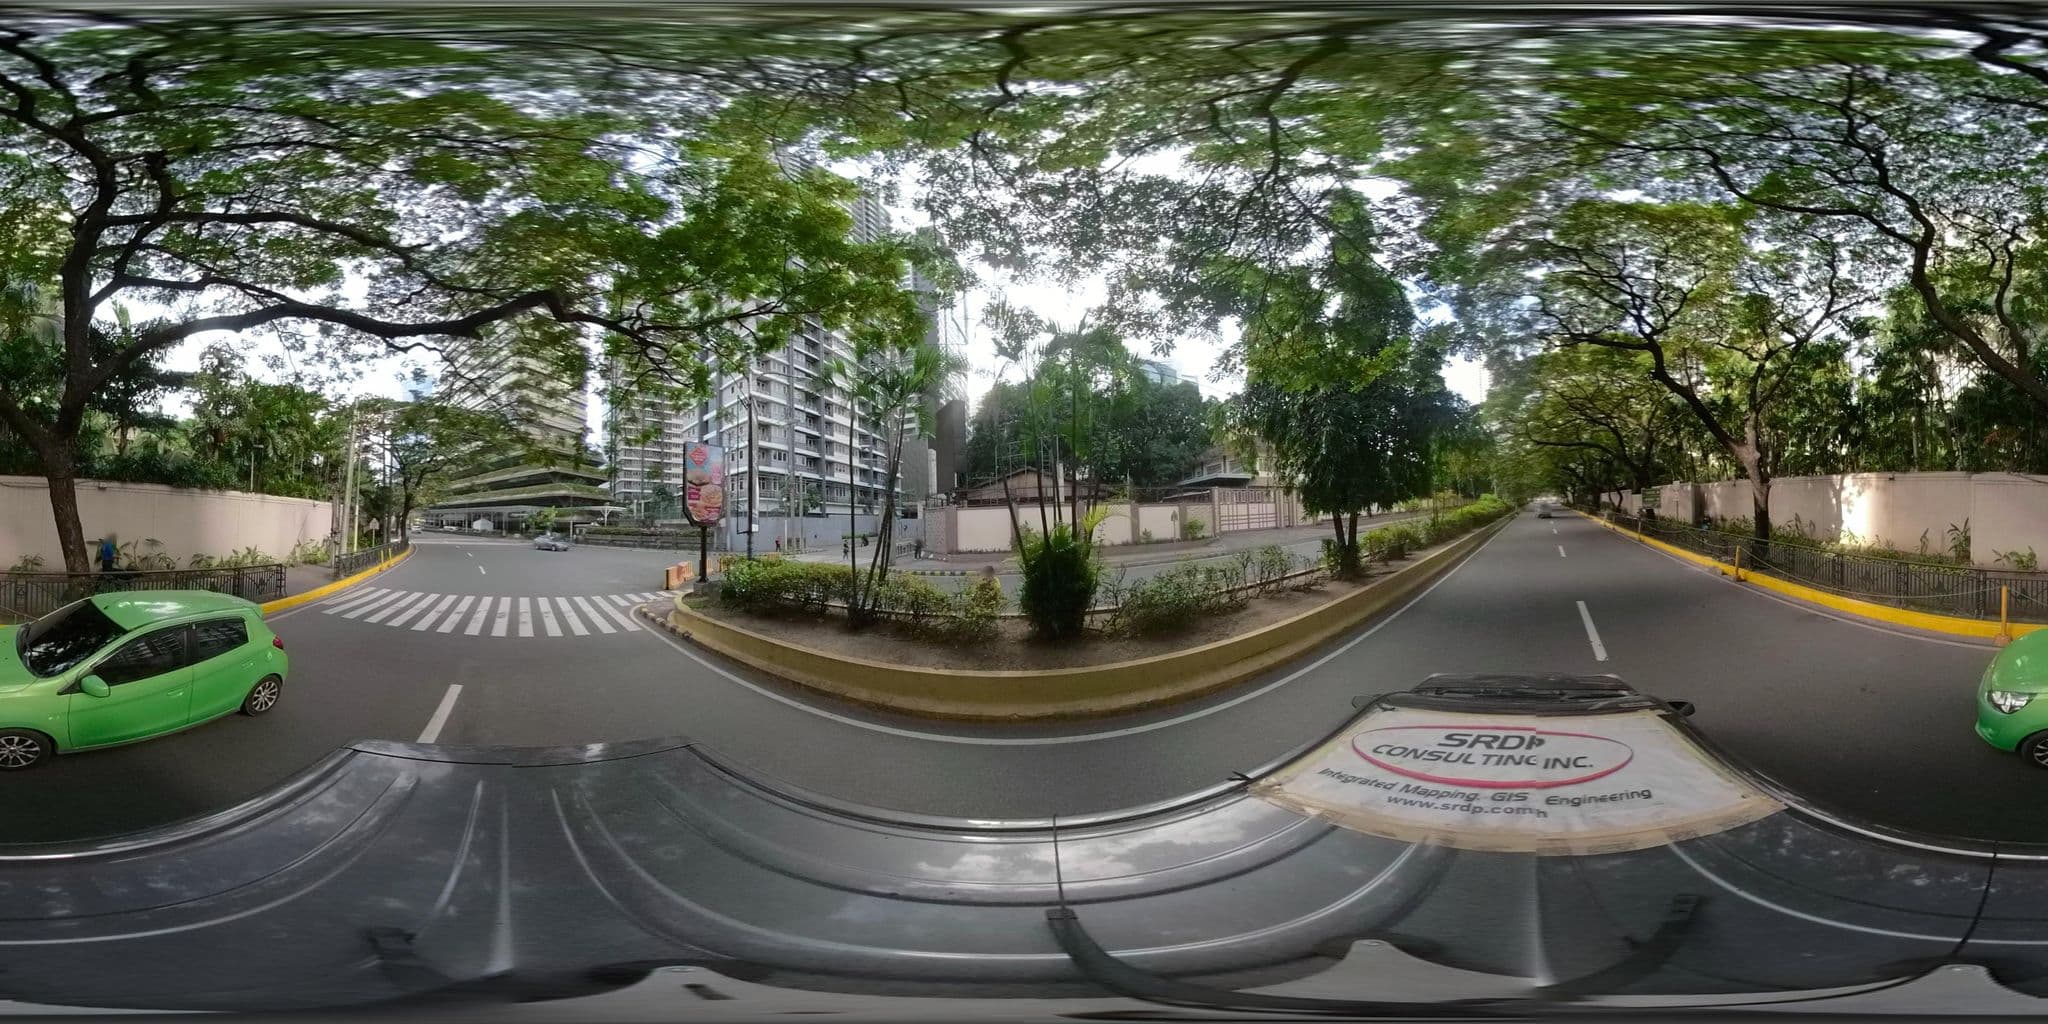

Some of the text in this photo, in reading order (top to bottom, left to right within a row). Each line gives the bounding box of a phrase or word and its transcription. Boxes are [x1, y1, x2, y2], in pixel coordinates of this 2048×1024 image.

[1438, 733, 1545, 750] SRDP
[1372, 744, 1593, 769] CONSULTING INC.
[1318, 768, 1398, 790] Integrated
[1490, 792, 1529, 801] GIS
[1545, 789, 1652, 807] Engineering
